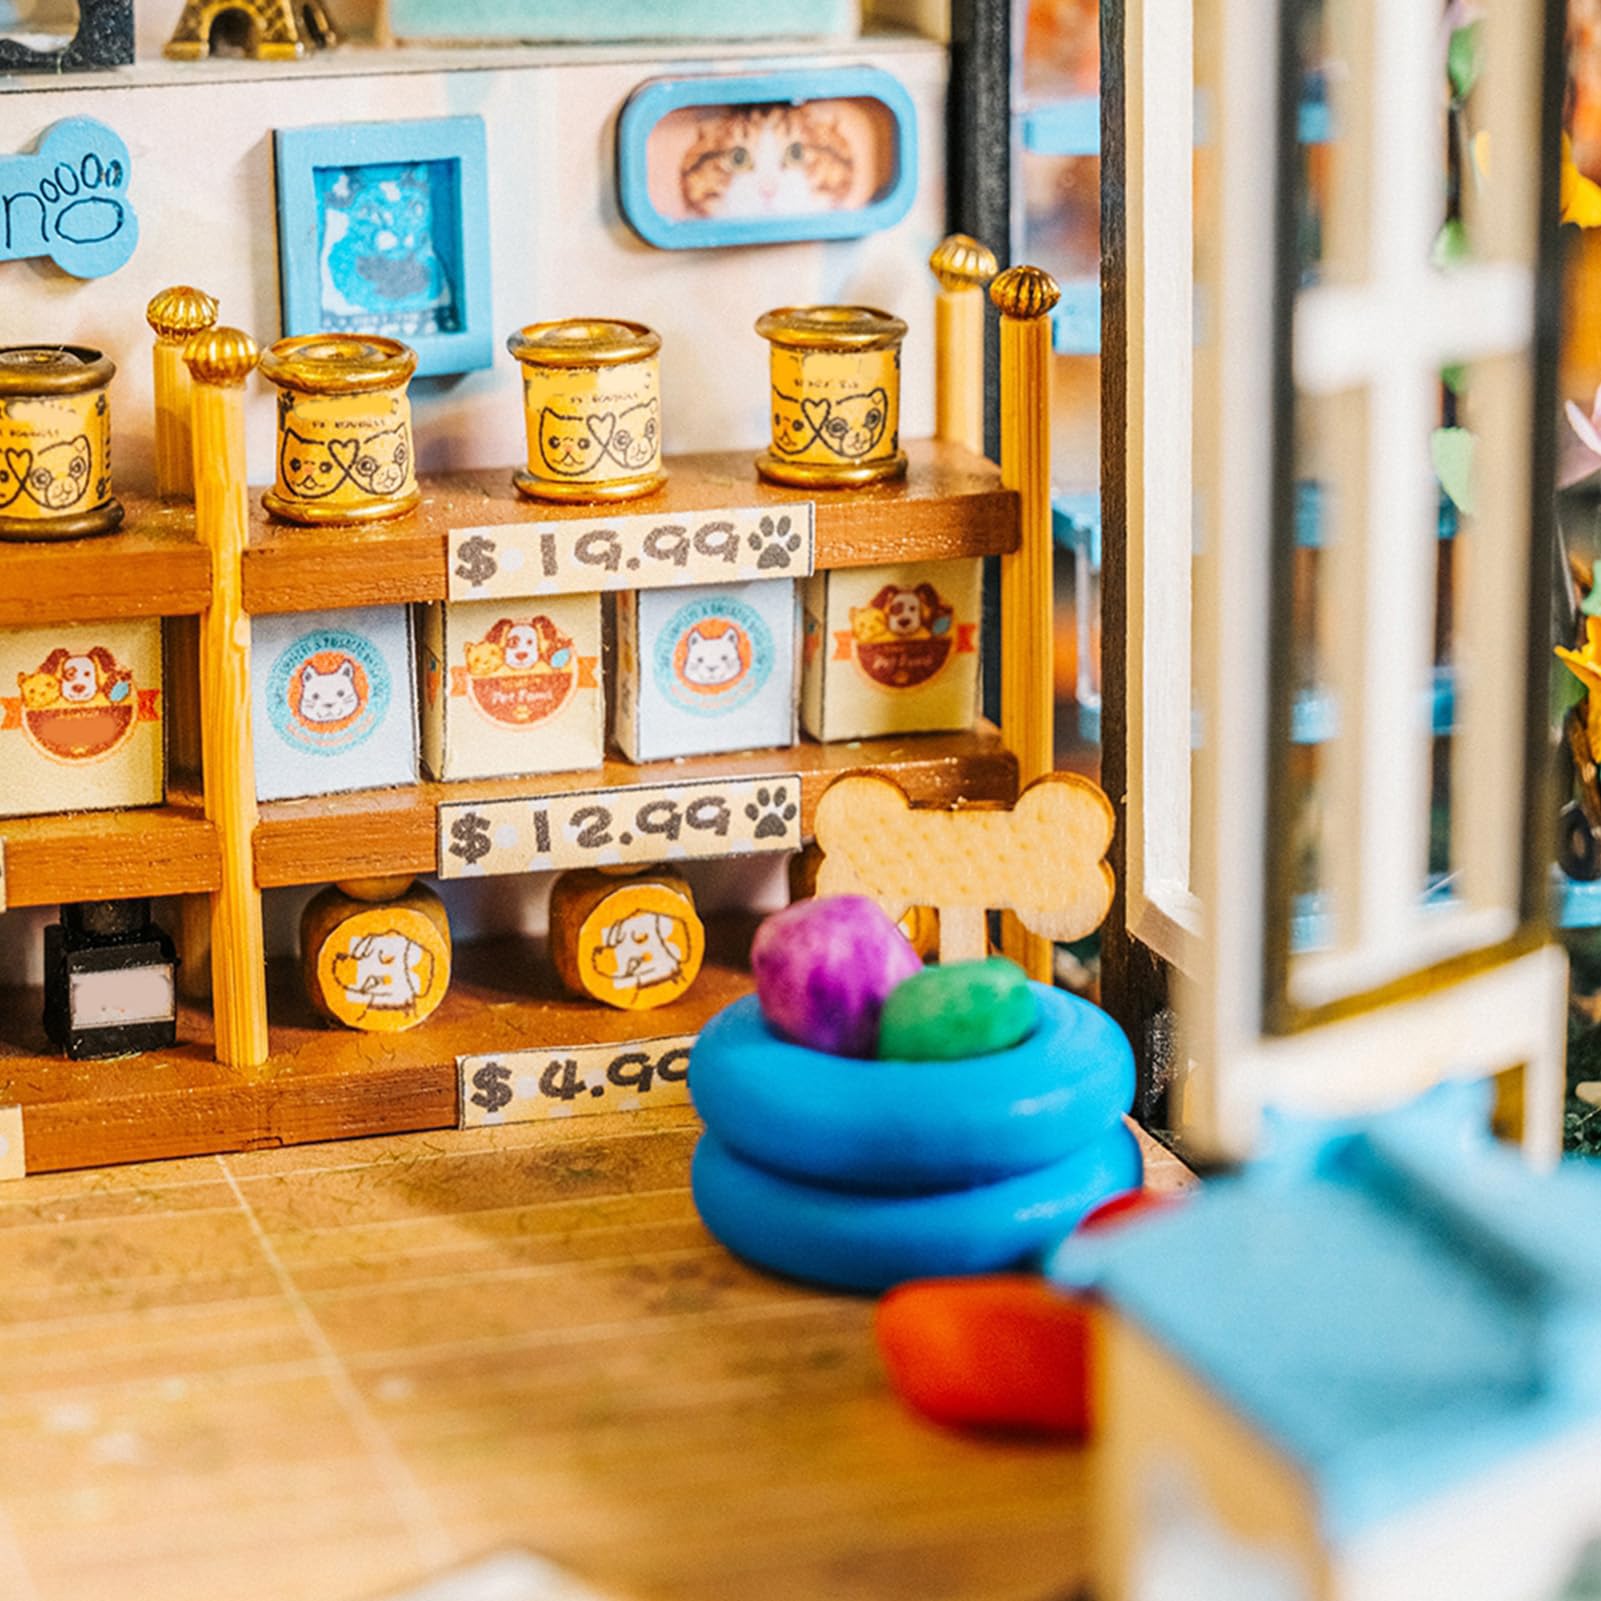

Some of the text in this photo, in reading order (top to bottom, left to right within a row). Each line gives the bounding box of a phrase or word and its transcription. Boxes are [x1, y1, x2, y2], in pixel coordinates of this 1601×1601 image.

[455, 521, 741, 588] $ 19.99
[448, 795, 732, 865] $ 12.99
[470, 1060, 513, 1113] $
